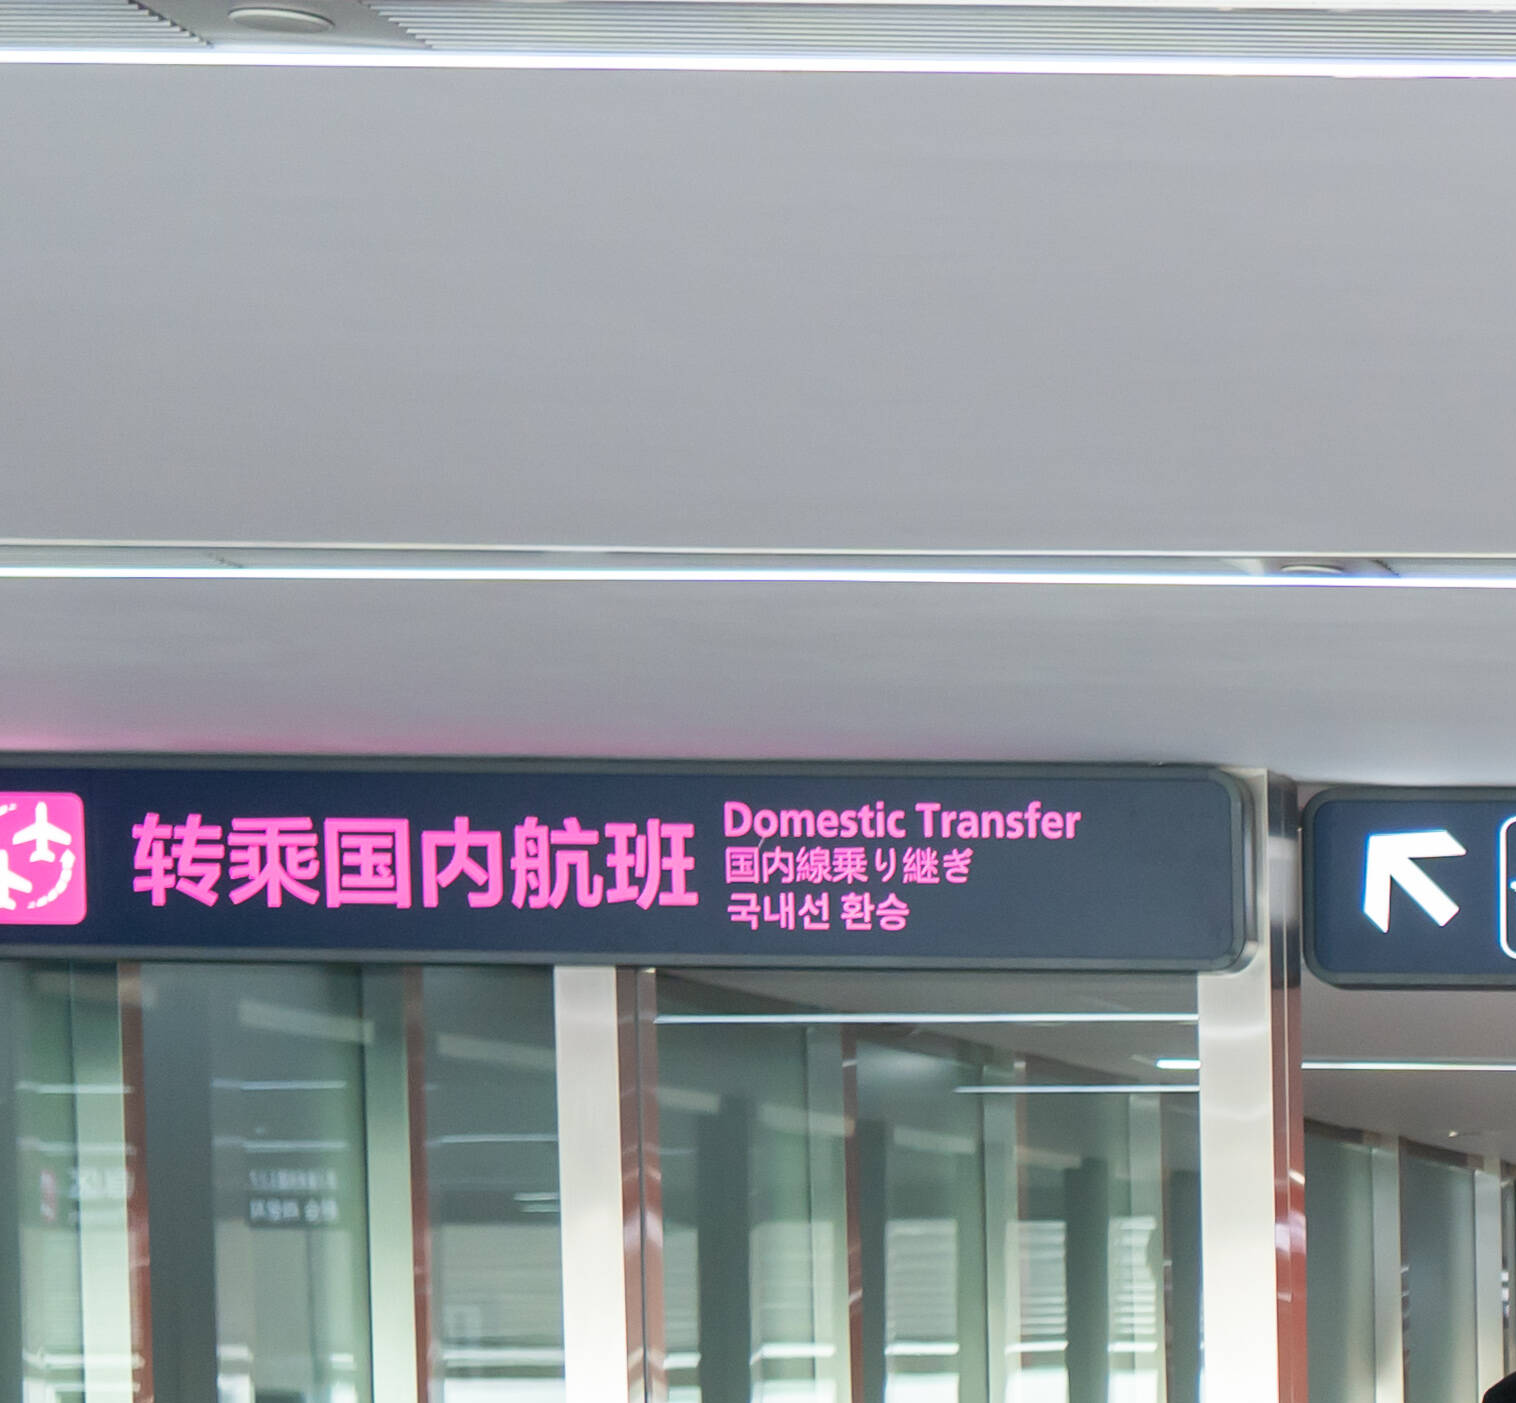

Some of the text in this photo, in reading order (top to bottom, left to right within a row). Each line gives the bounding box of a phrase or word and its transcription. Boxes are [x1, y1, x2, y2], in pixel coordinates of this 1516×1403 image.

[723, 800, 1083, 842] Domestic Transfer
[131, 811, 701, 912] 转乘国内航班
[724, 846, 974, 887] 国内線乗り継ぎ
[726, 891, 911, 935] 국내선 환승
